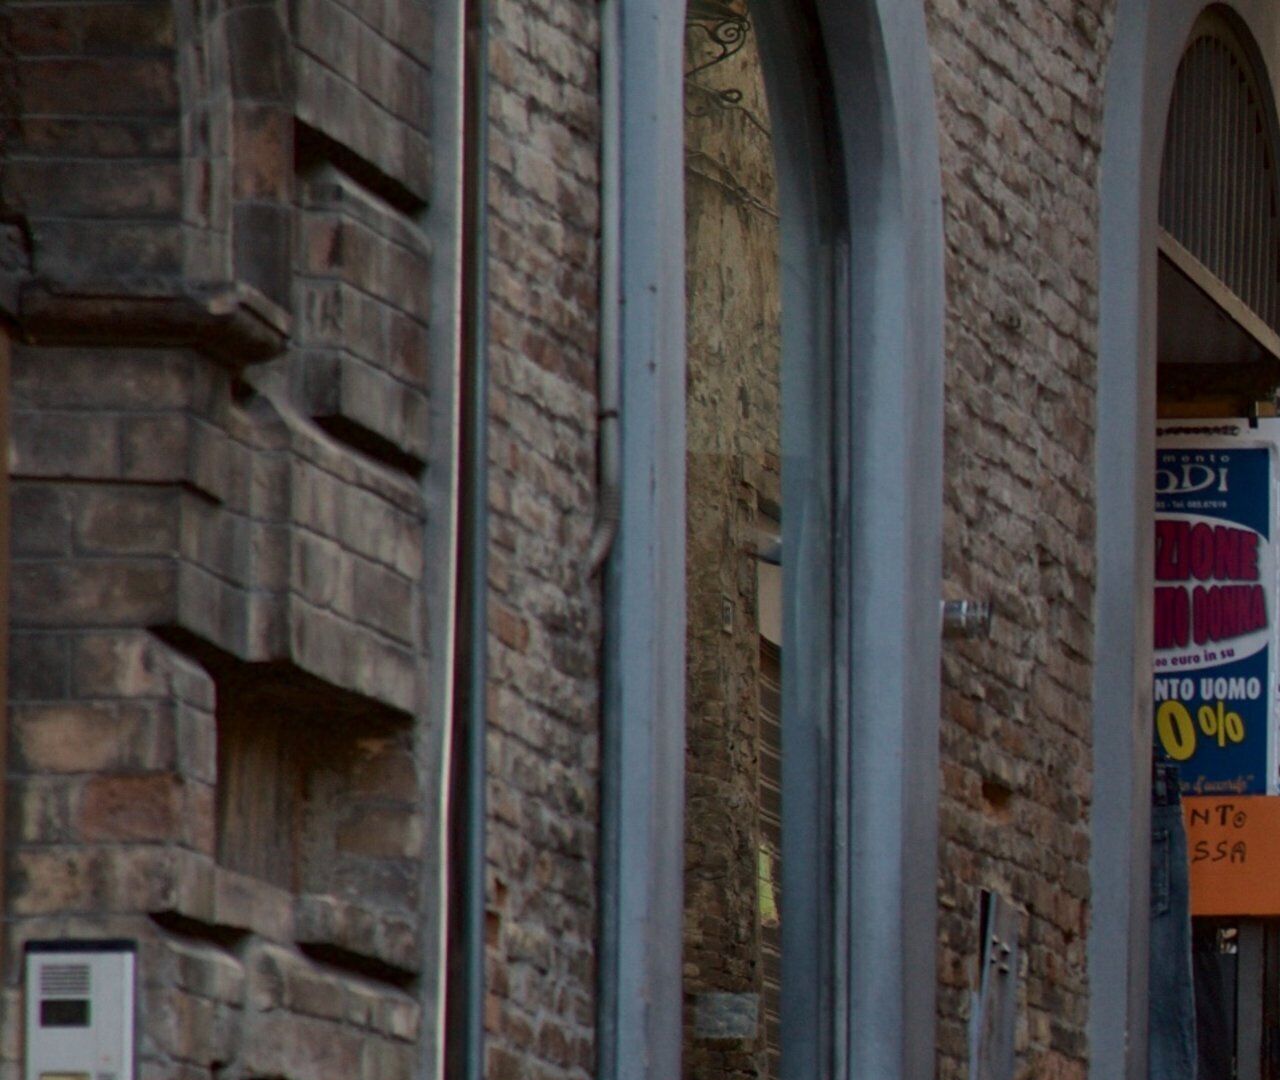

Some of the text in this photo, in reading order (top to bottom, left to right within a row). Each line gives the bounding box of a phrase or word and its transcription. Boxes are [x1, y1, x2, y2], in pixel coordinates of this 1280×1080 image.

[1171, 656, 1201, 666] euro
[1204, 649, 1217, 661] in
[1221, 648, 1236, 659] su
[1201, 677, 1261, 701] UOMO
